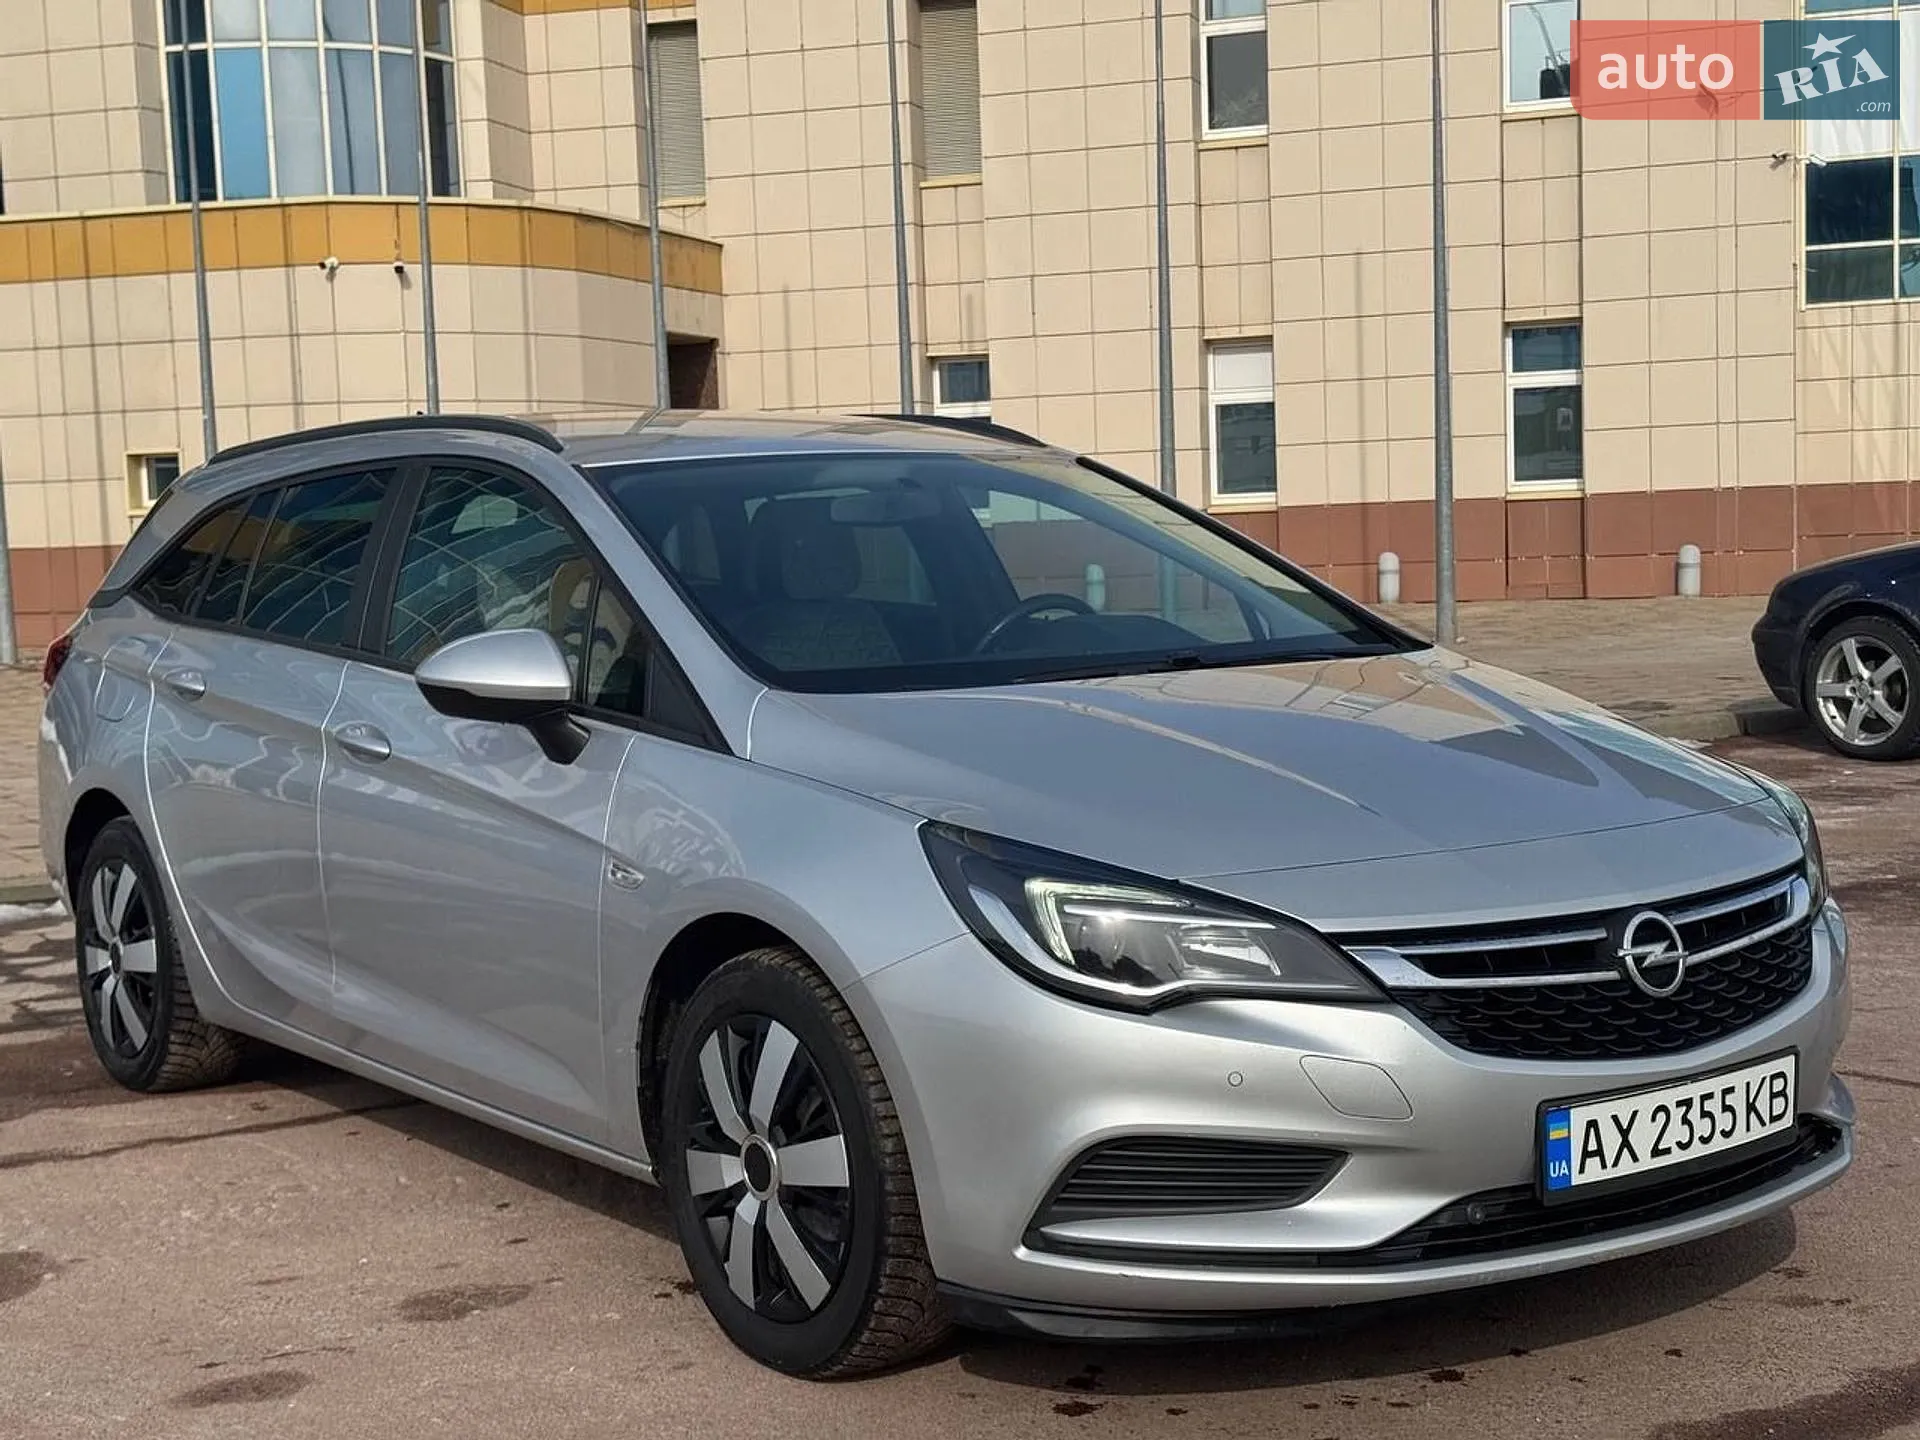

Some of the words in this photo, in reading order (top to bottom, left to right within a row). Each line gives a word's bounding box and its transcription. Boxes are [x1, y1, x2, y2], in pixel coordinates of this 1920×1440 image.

[1578, 1109, 1640, 1175] AX
[1650, 1086, 1737, 1158] 2355
[1745, 1071, 1789, 1132] KB
[1550, 1162, 1569, 1178] UA
